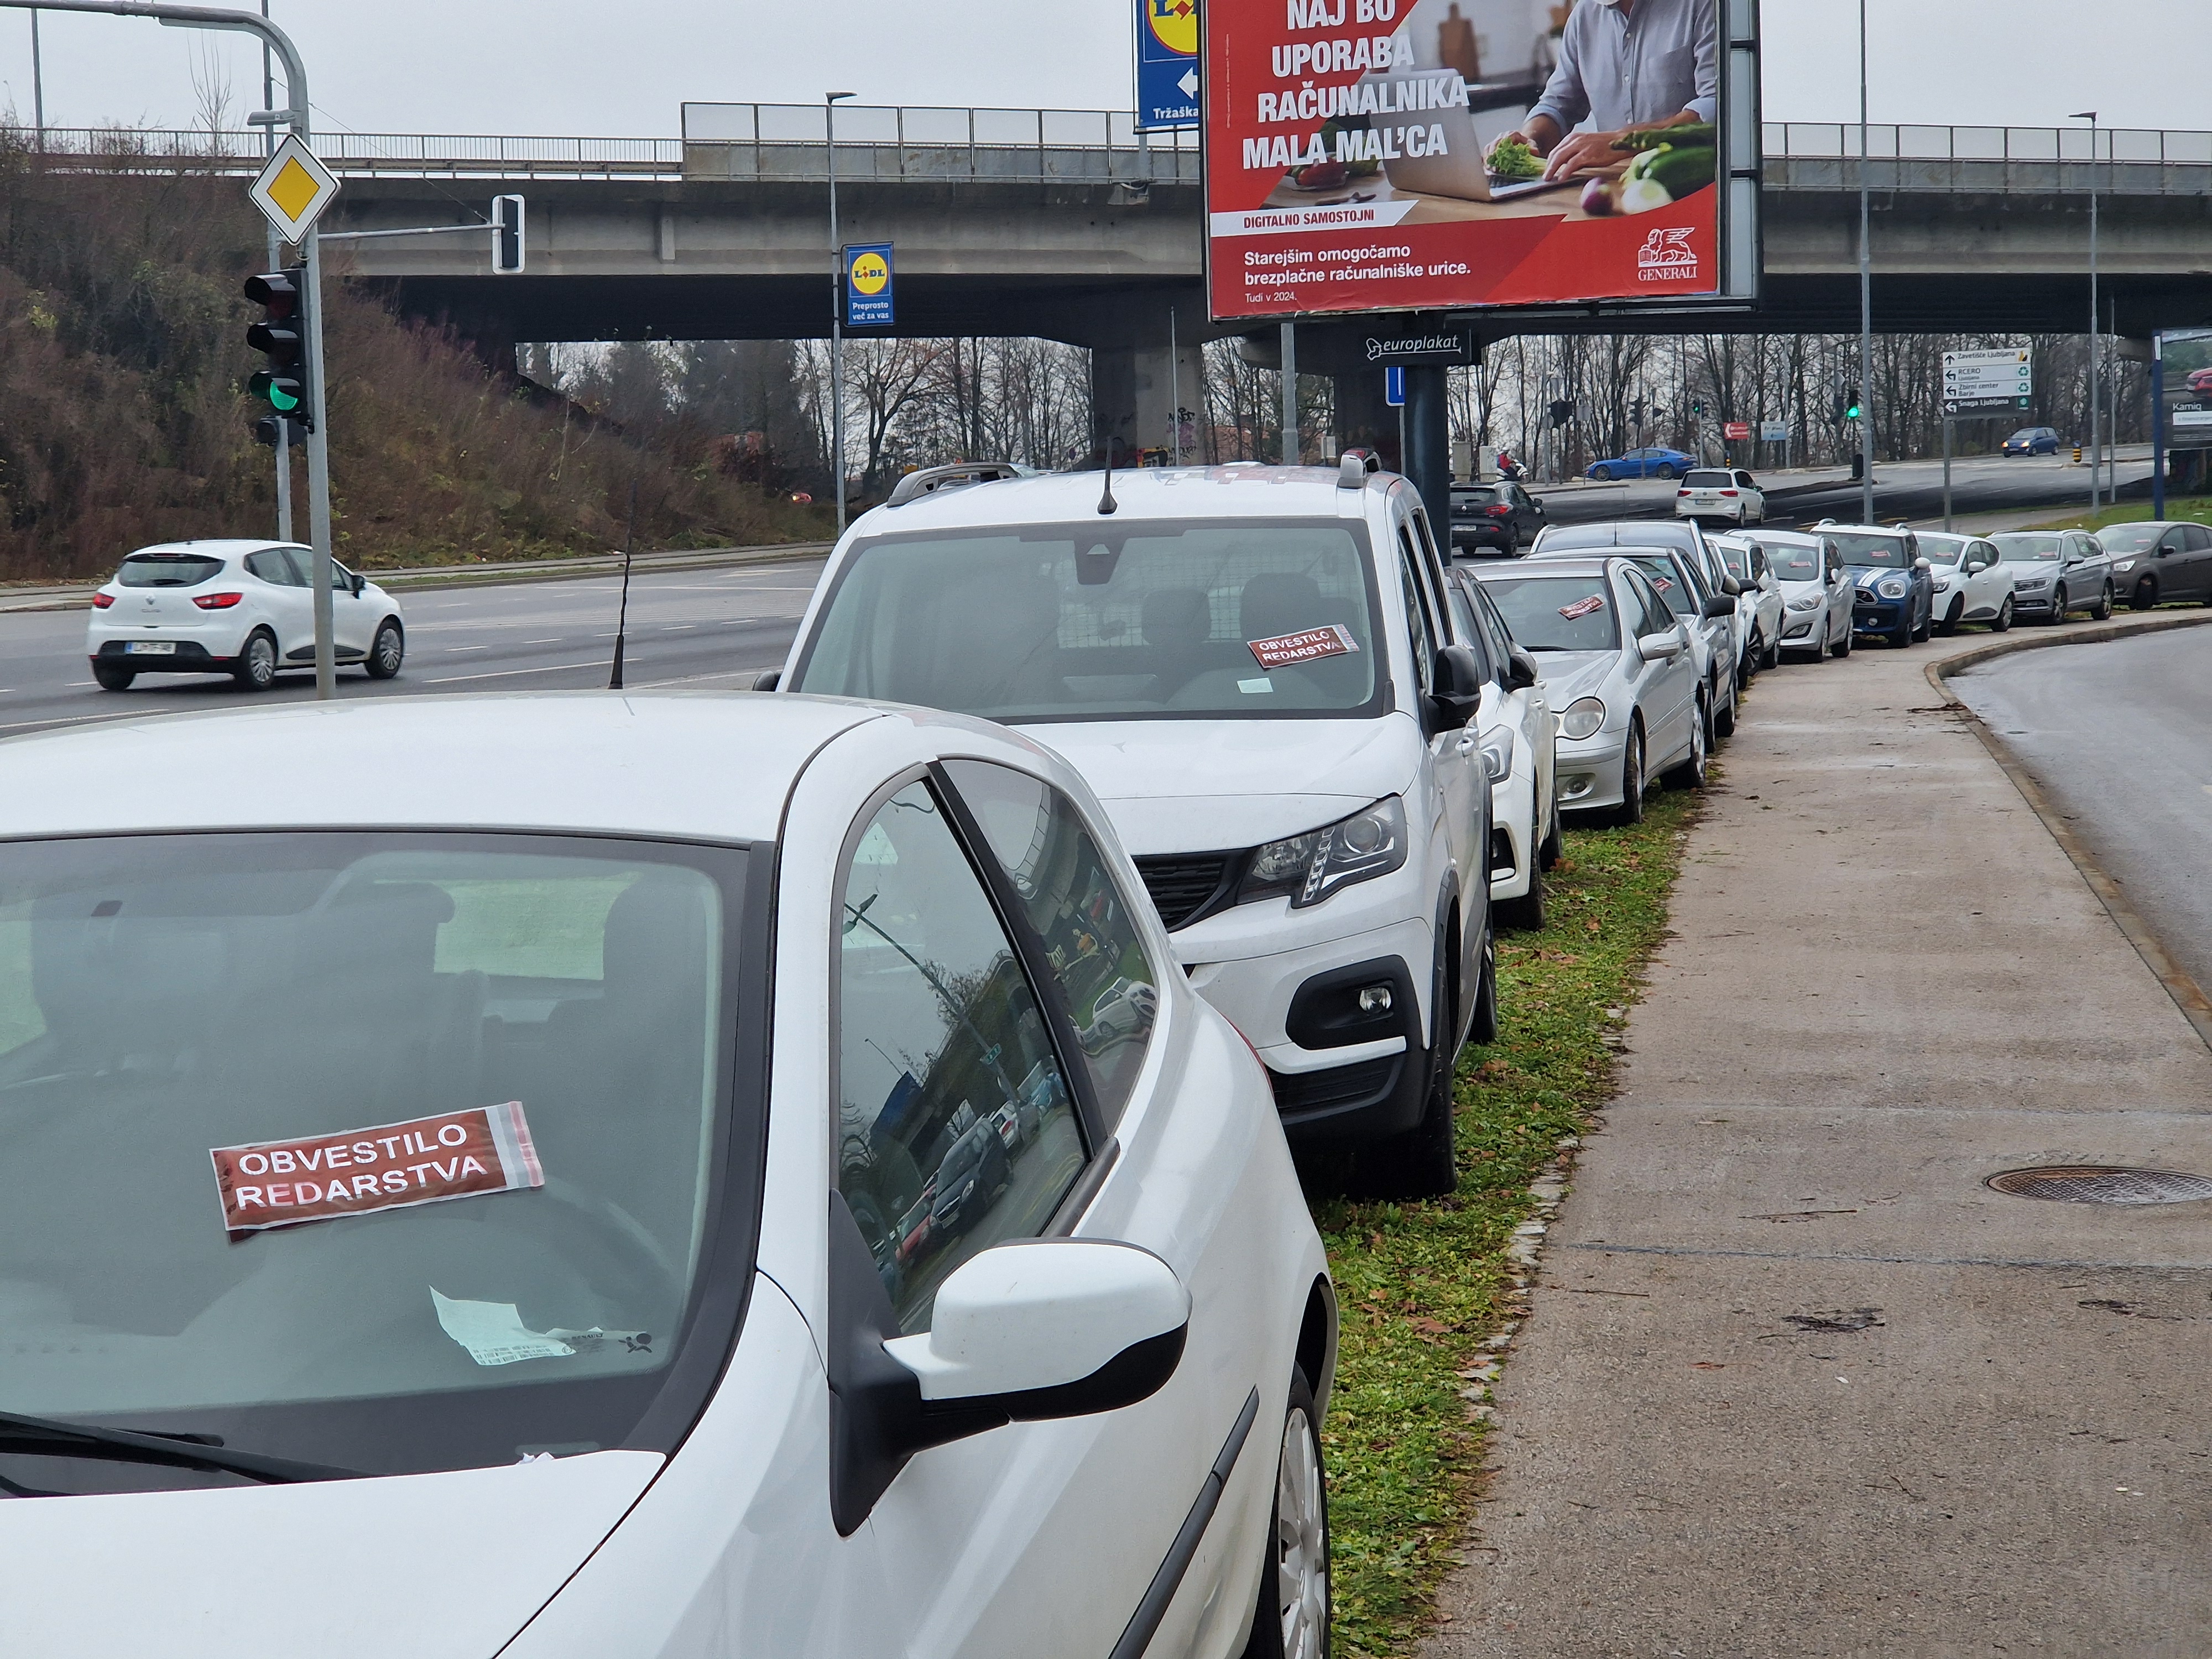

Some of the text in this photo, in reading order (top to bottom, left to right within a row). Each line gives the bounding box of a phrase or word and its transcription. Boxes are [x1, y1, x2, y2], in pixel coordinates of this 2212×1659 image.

[1287, 0, 1395, 30] NAJ BO
[1272, 34, 1415, 77] UPORABA
[1258, 76, 1470, 123] RAČUNALNIKA
[1152, 106, 1199, 119] Tržaška
[1243, 133, 1328, 170] MALA
[1244, 209, 1374, 228] DIGITALNO SAMOSTOJNI
[1244, 244, 1411, 266] Starejšim omogočamo
[1245, 260, 1471, 286] brezplačne računalniške urice.
[1638, 266, 1697, 281] GENERALI
[852, 301, 889, 311] Preprosto
[1245, 291, 1297, 303] Tudi v 2024.
[852, 312, 866, 320] več
[1383, 334, 1459, 352] europlakat
[1987, 351, 2016, 359] Ljubljana
[1980, 398, 2010, 406] Ljubljana
[1259, 631, 1330, 651] OBVESTILO
[1262, 641, 1341, 662] REDARSTVA
[238, 1124, 467, 1176] OBVESTILO
[235, 1155, 488, 1210] REDARSTVA
